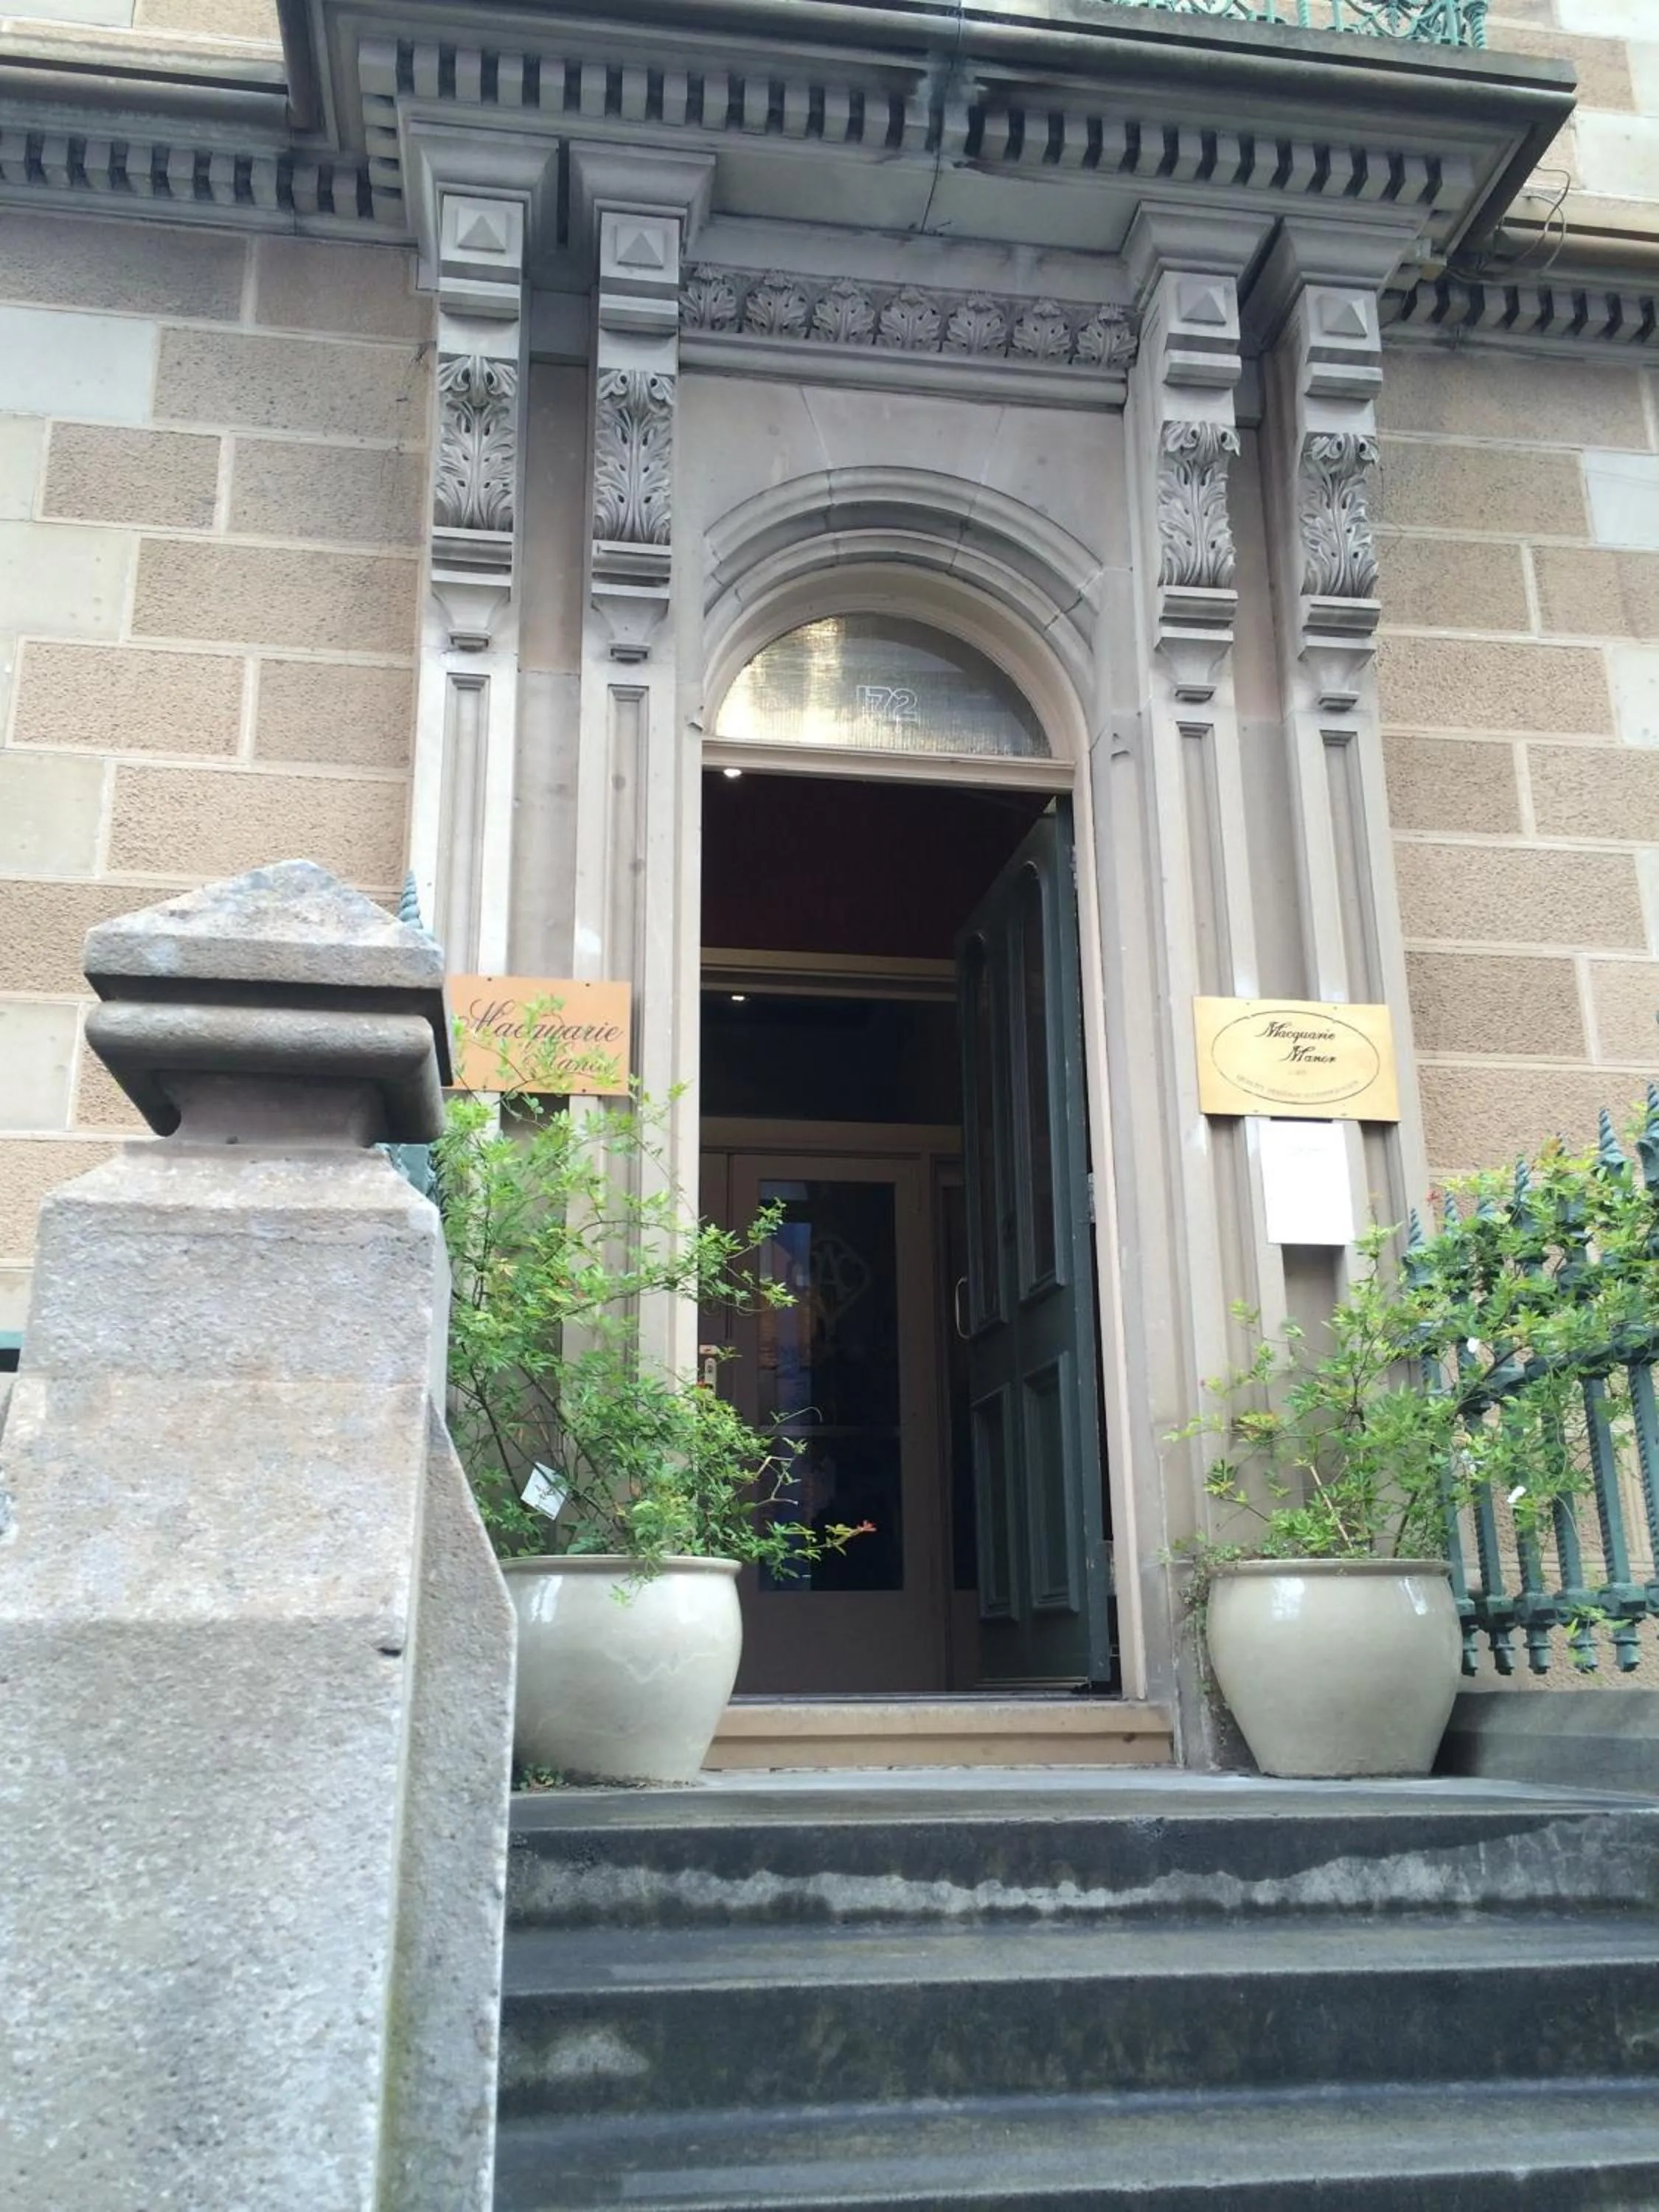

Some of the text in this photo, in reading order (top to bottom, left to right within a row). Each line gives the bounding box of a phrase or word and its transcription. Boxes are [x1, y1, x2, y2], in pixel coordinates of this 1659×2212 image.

[856, 684, 919, 722] 172
[1254, 1021, 1336, 1043] Macquarie
[1279, 1045, 1336, 1062] Manor
